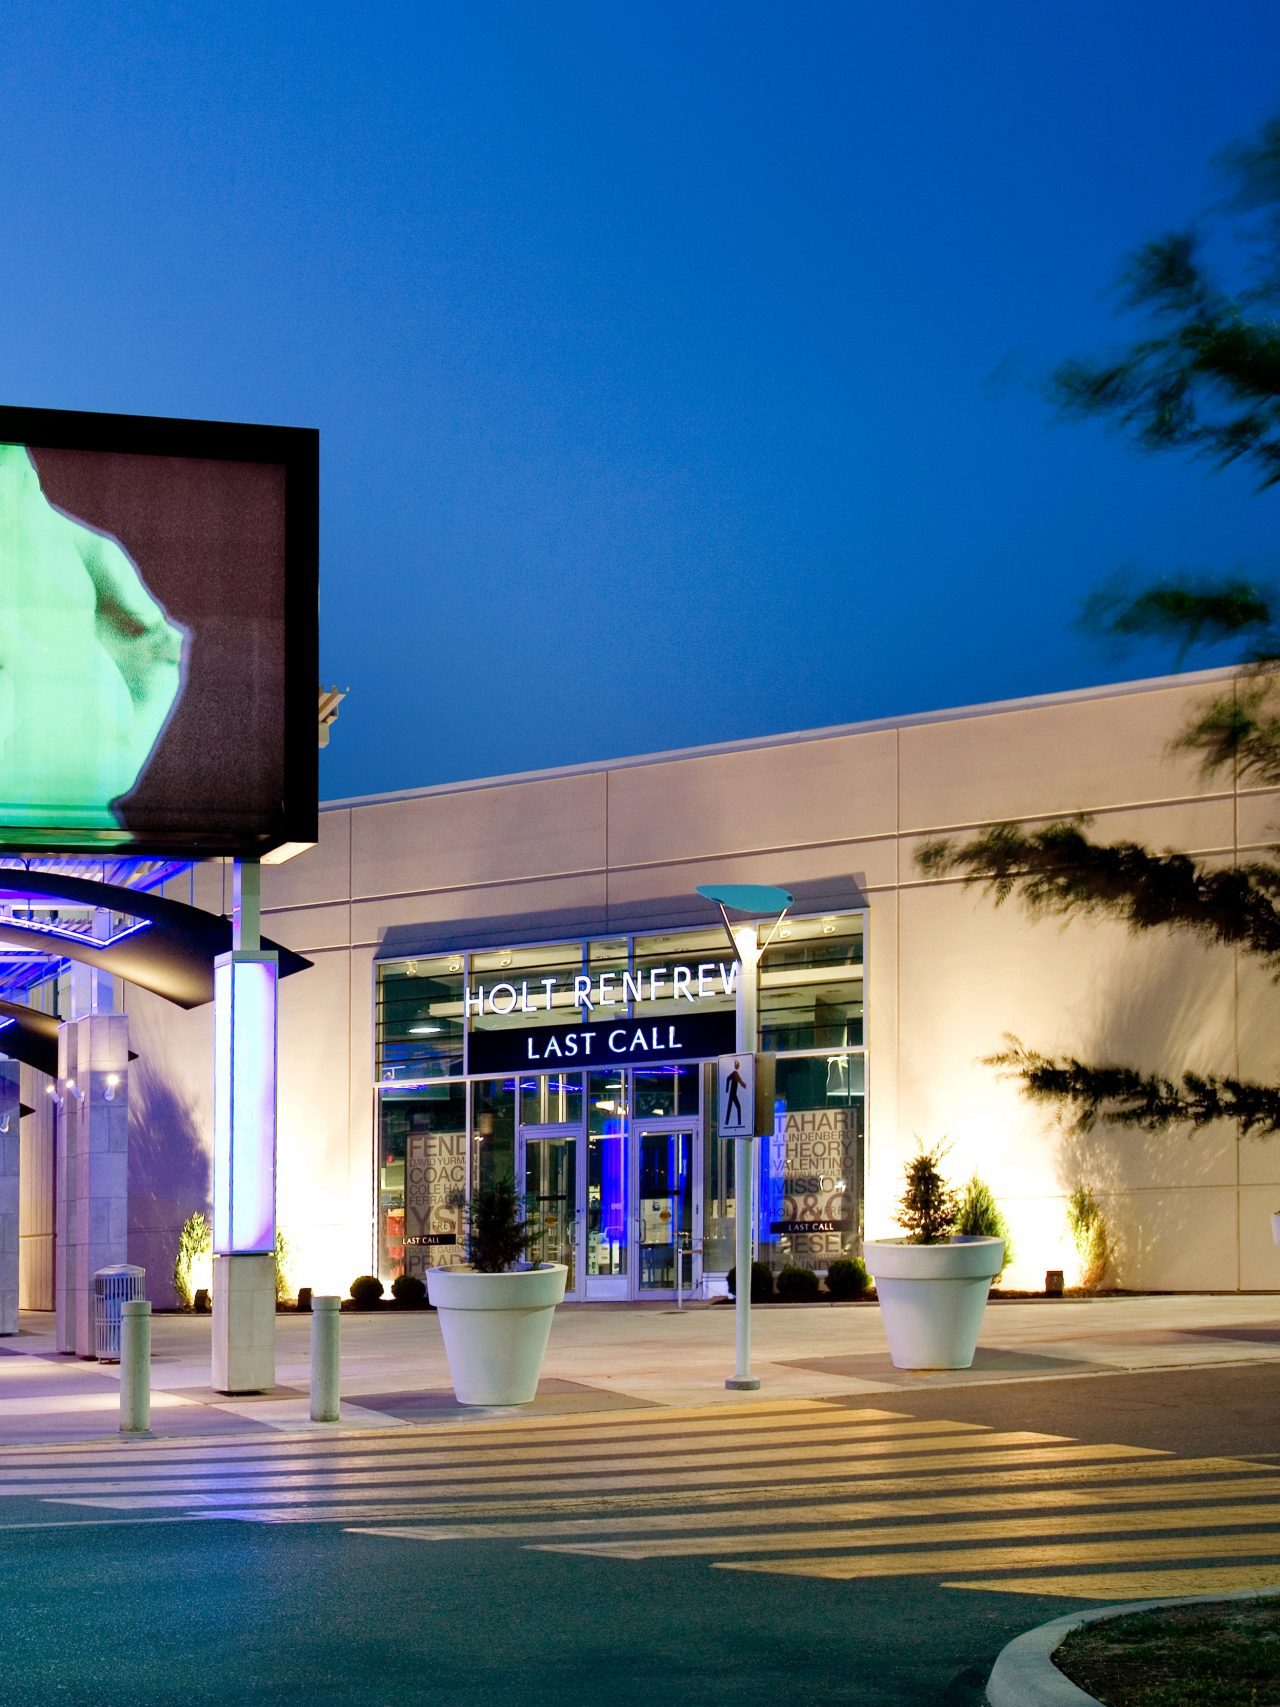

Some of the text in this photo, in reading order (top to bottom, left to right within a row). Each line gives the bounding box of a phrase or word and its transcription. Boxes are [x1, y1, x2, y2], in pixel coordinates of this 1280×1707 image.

[465, 960, 738, 1018] HOLT RENFREW
[527, 1026, 683, 1060] LAST CALL
[774, 1111, 854, 1133] TAHARI
[409, 1134, 478, 1158] FENDI
[773, 1141, 852, 1159] THEORY
[409, 1155, 478, 1167] DAVID YURMN
[773, 1156, 854, 1171] VALENTINO
[409, 1165, 478, 1185] COACH
[409, 1183, 441, 1195] COLE
[788, 1222, 834, 1231] LAST CALL
[402, 1236, 440, 1246] LAST CALL
[409, 1254, 465, 1273] PRAD
